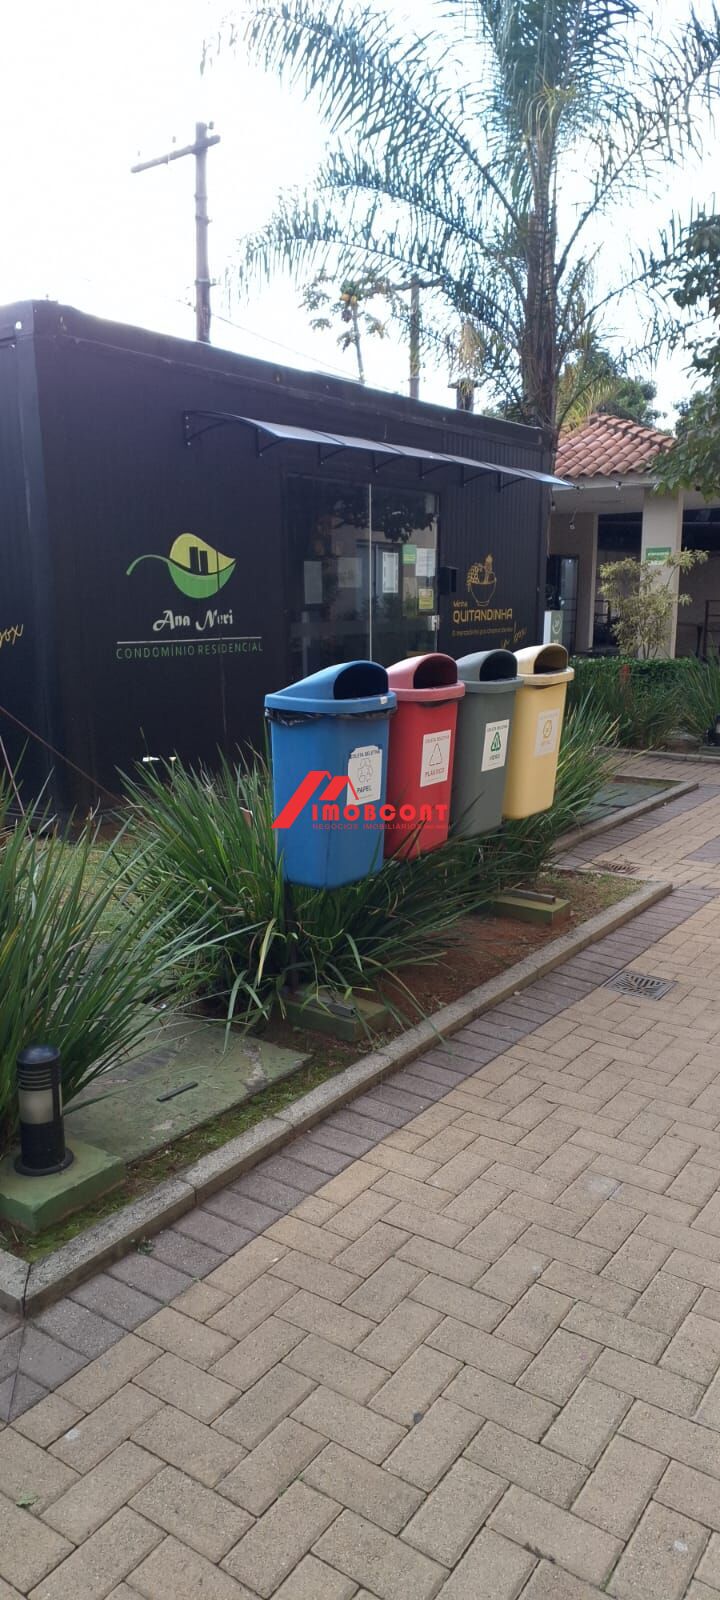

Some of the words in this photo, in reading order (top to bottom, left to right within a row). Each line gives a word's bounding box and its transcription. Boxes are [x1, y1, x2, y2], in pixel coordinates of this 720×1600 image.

[152, 609, 190, 631] Ana
[453, 608, 513, 624] QUITANDINHA
[116, 644, 195, 660] CONDOMÍNIO
[197, 641, 263, 656] RESIDENCIAL
